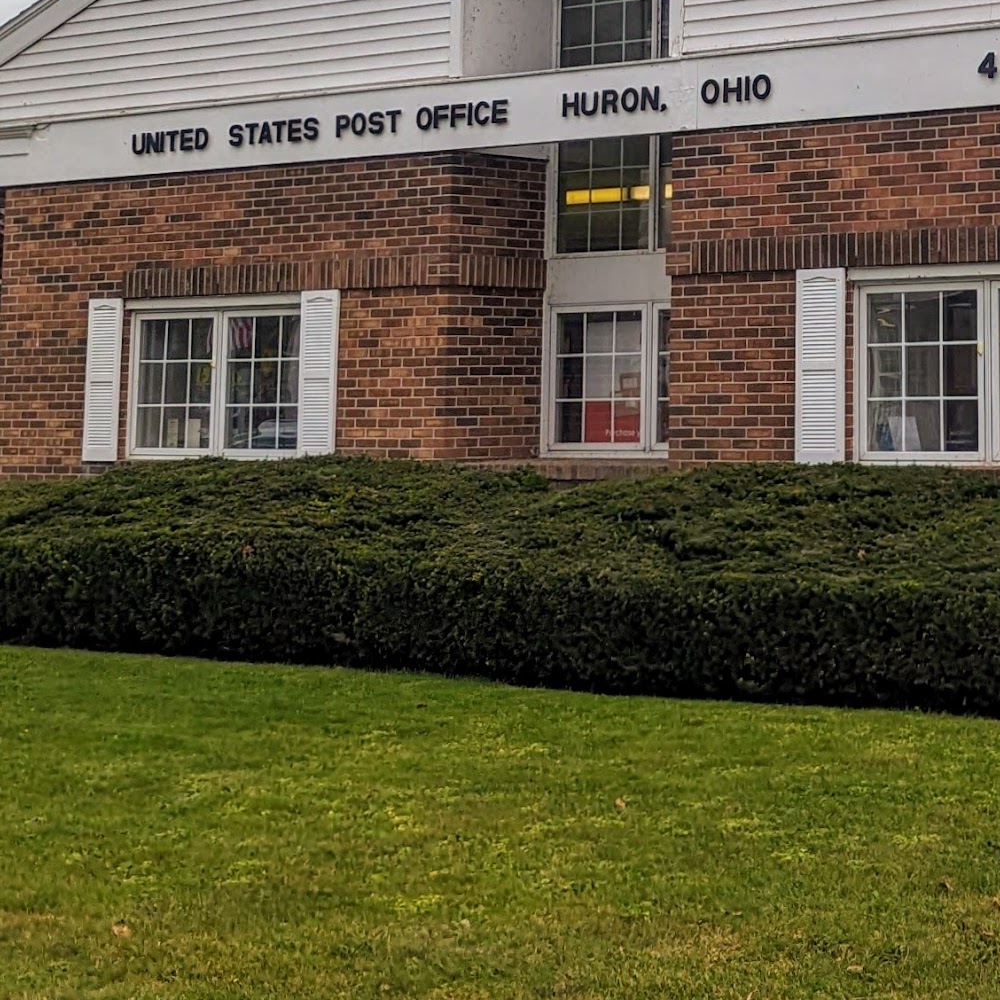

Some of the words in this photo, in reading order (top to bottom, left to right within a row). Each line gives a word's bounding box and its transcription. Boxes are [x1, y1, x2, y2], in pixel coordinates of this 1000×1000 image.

[132, 128, 209, 156] UNITED
[229, 117, 320, 149] STATES
[336, 109, 402, 138] POST
[416, 99, 509, 133] OFFICE
[562, 85, 667, 117] HURON,
[701, 74, 772, 105] OHIO
